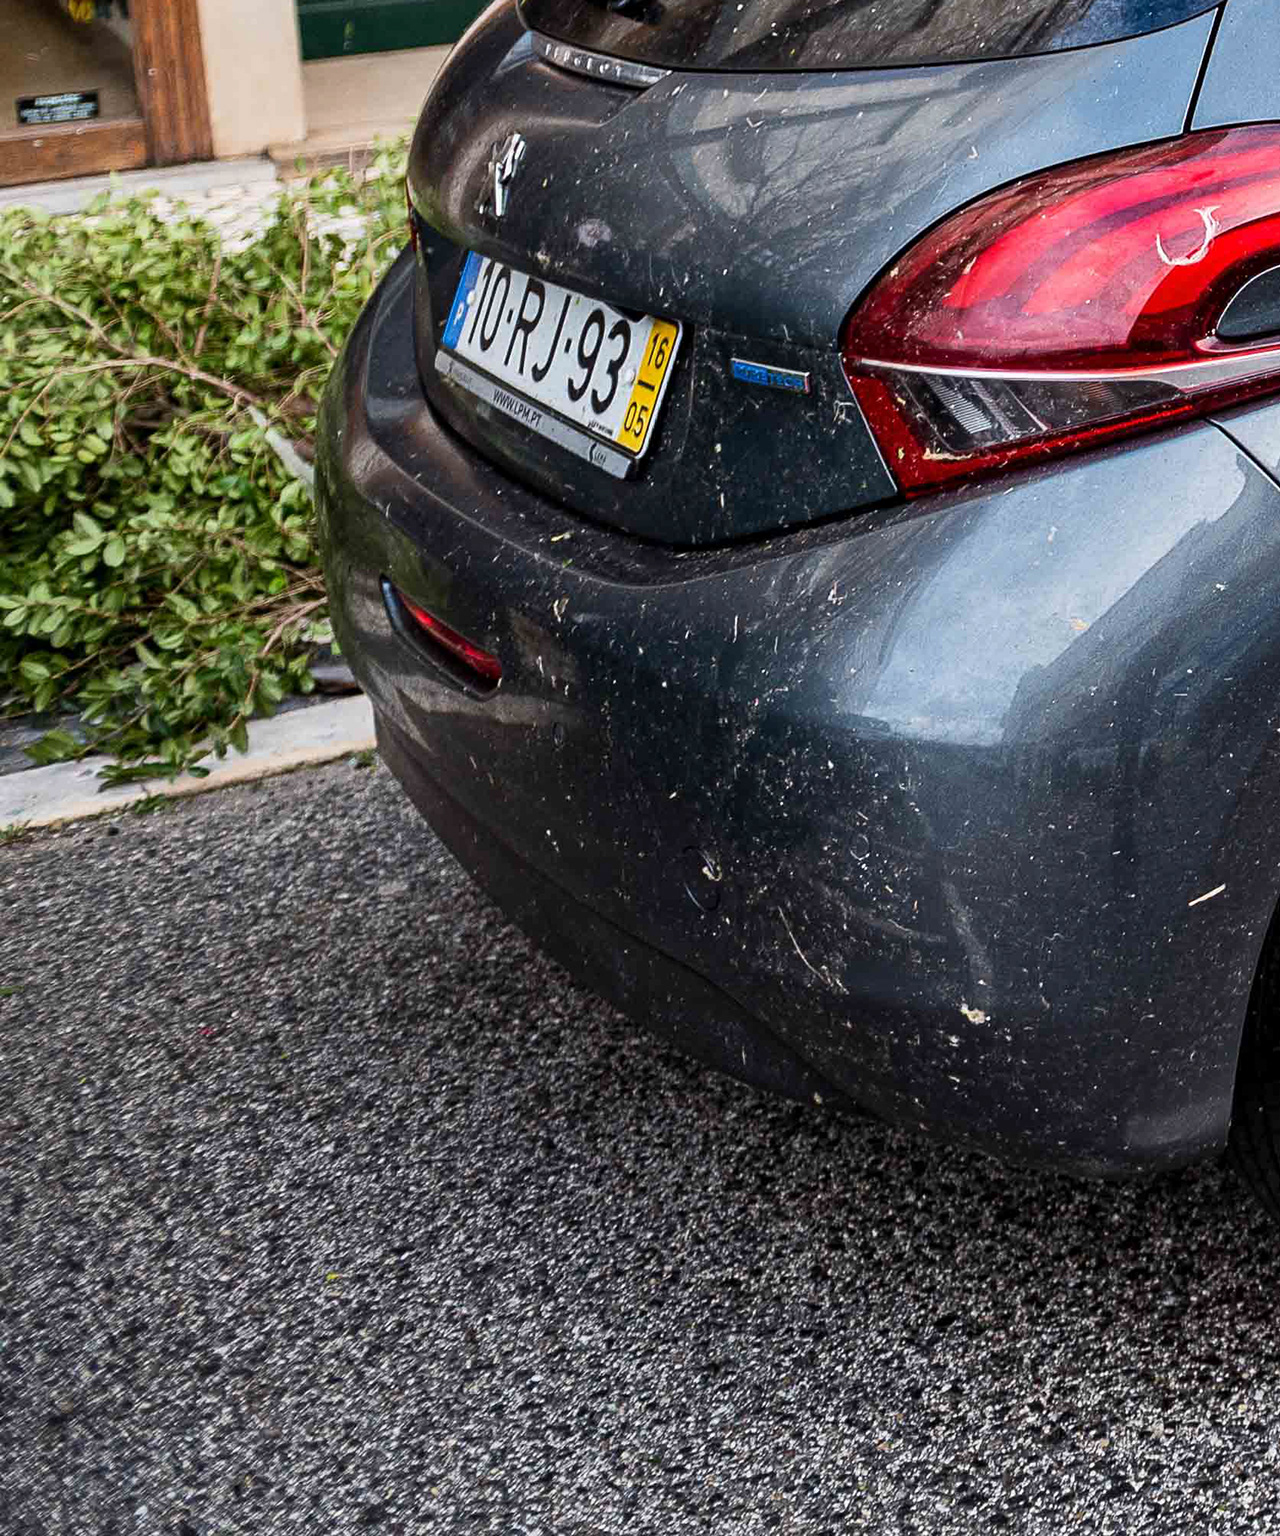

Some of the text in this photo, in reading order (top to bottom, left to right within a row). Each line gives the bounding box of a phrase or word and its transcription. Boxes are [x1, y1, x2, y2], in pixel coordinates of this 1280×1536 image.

[452, 301, 465, 326] P
[467, 260, 633, 415] 10-RJ-93
[646, 332, 670, 370] 16
[492, 388, 543, 428] WWW.LPM.PT
[623, 400, 650, 439] 05
